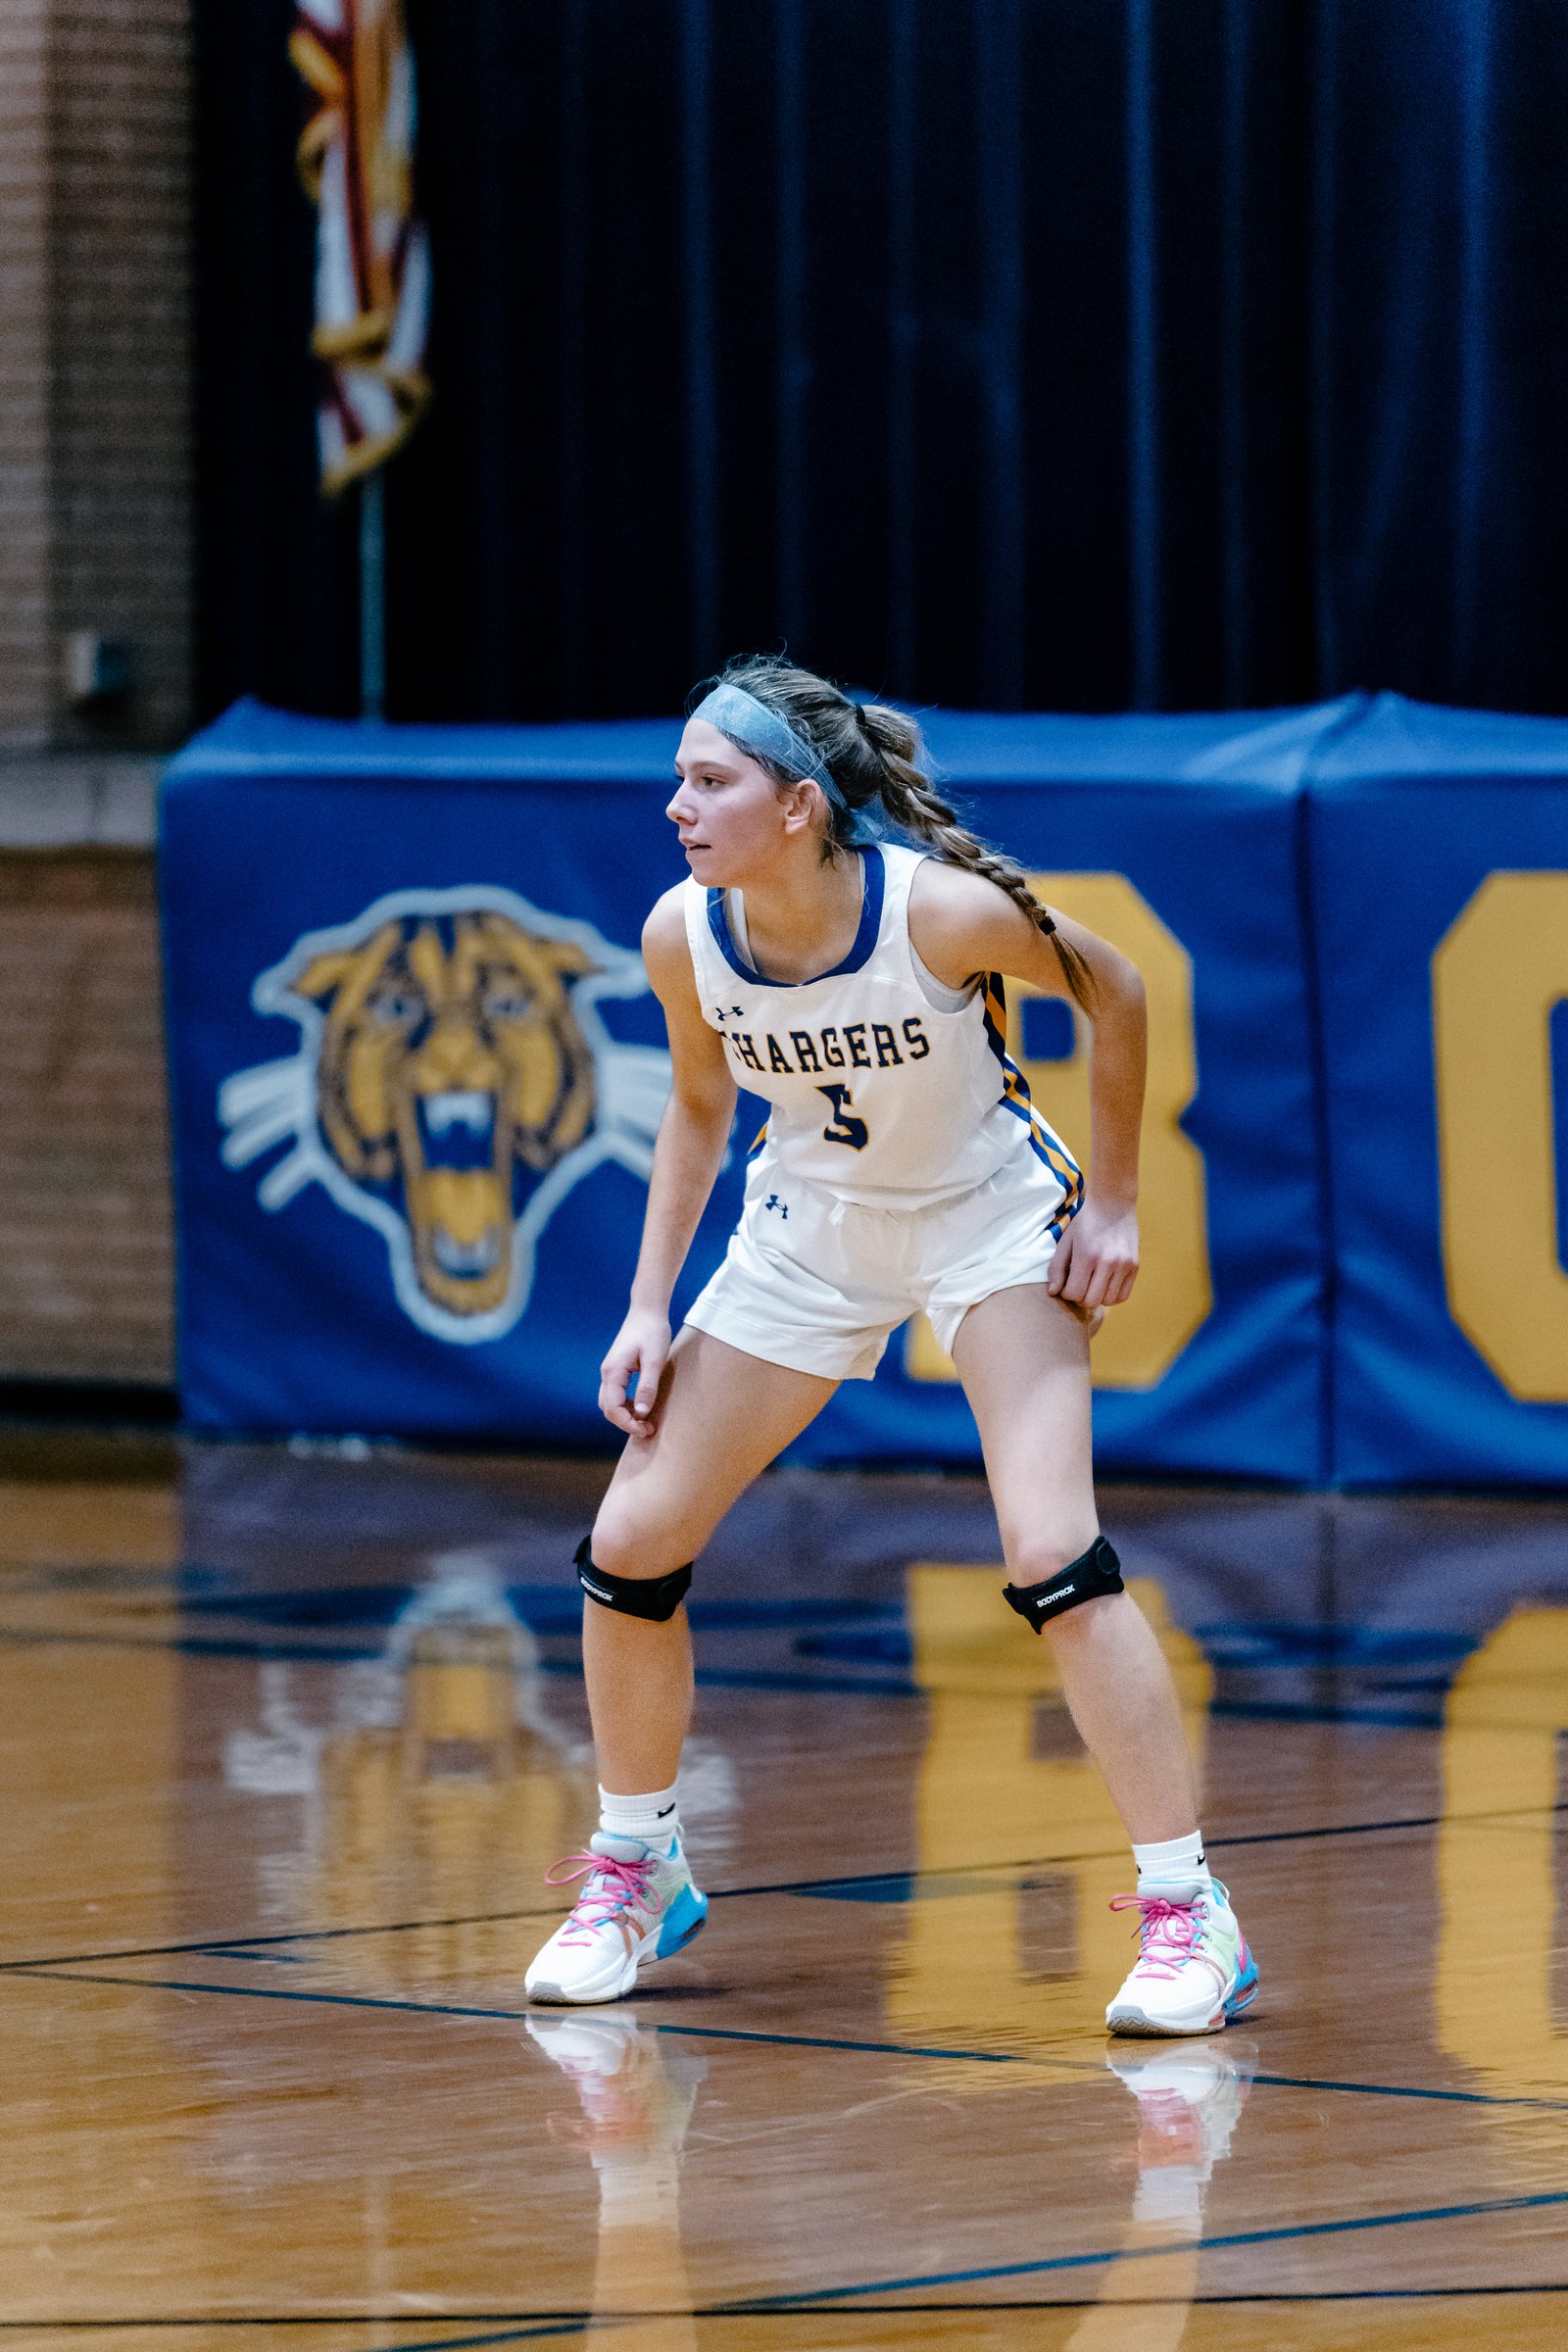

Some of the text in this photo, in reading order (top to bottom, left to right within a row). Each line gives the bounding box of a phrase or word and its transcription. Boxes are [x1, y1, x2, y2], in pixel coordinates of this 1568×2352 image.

[719, 1017, 930, 1073] HARGERS
[814, 1083, 869, 1152] 5
[1036, 1584, 1075, 1607] BODYPROX
